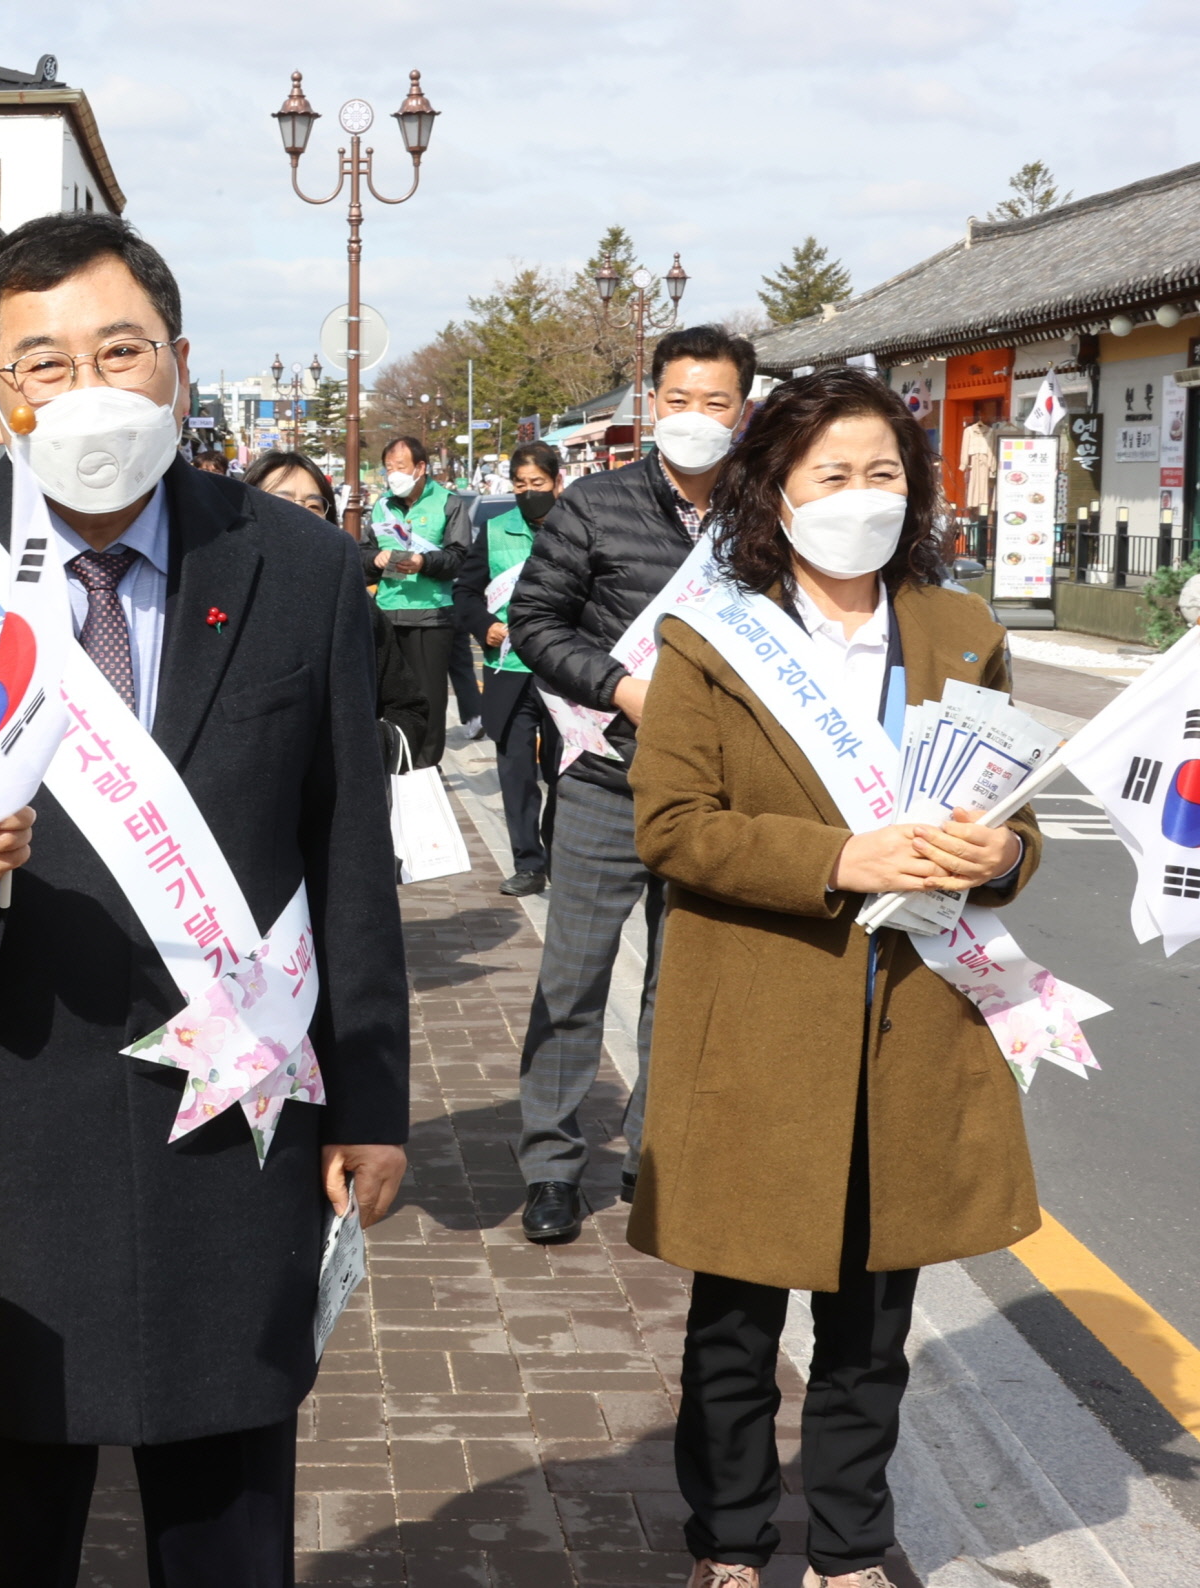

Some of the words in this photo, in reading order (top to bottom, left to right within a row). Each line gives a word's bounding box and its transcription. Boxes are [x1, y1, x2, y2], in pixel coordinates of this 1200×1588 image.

[716, 603, 788, 664] 통일의
[776, 658, 827, 708] 성지
[814, 707, 863, 760] 경주
